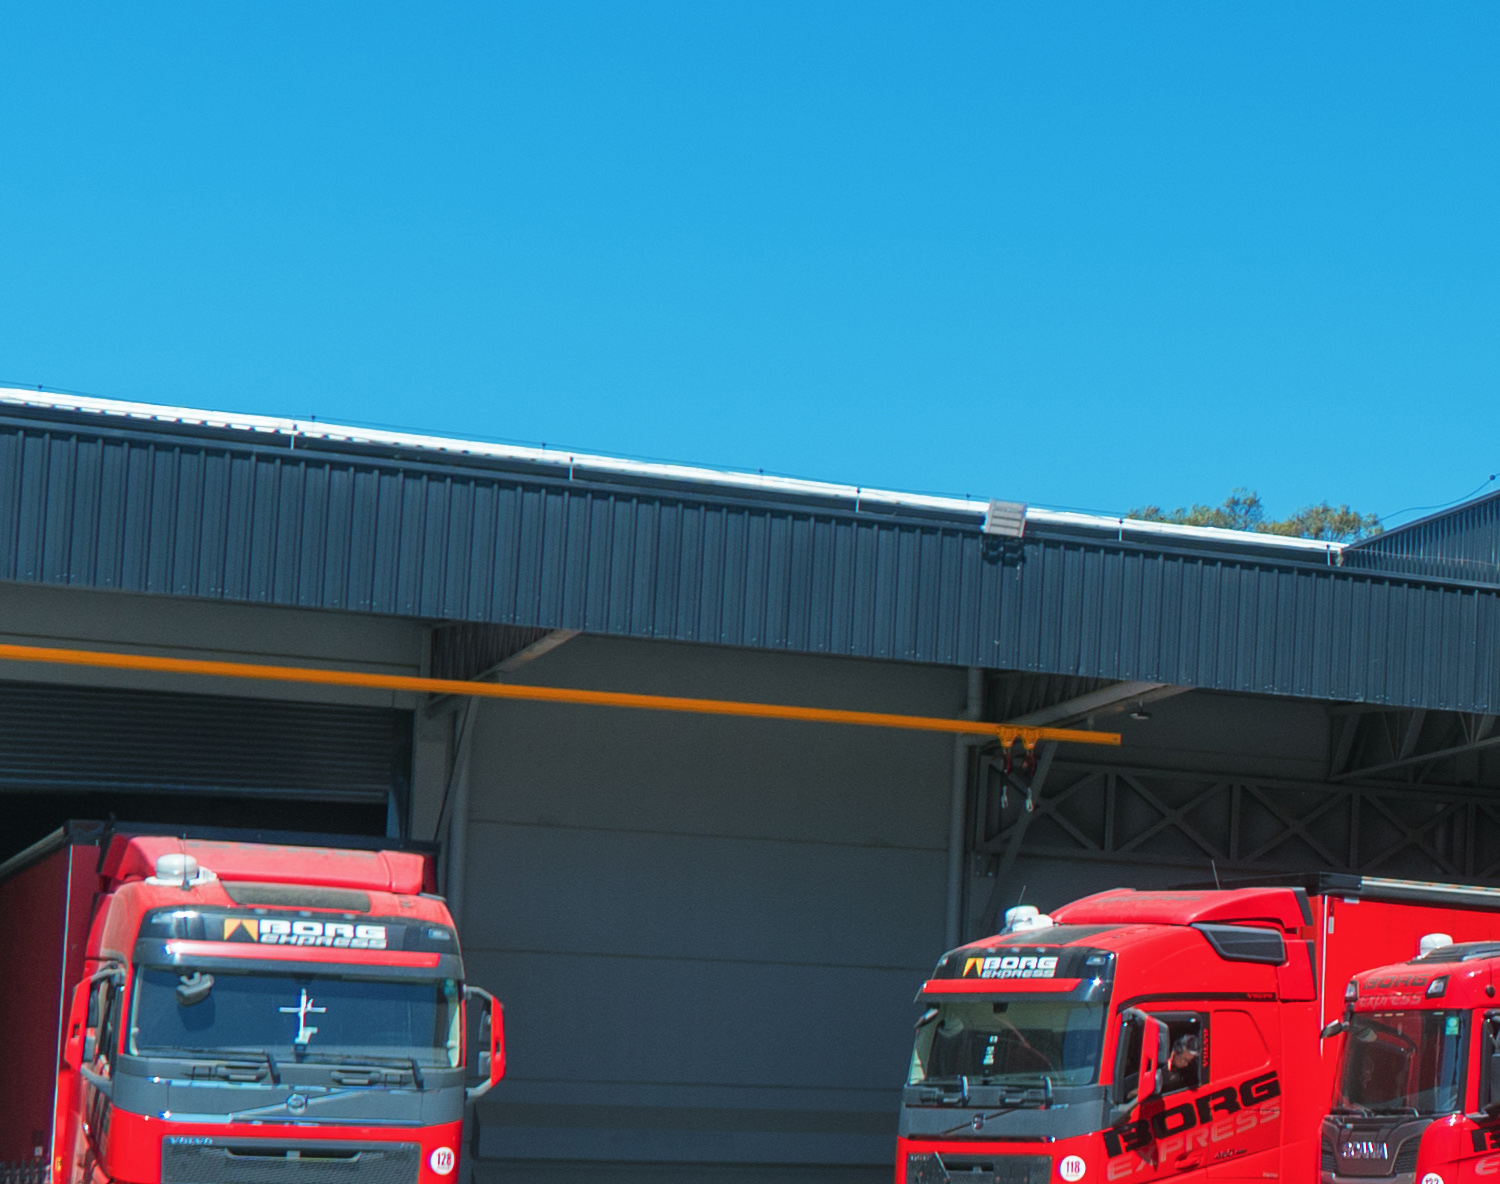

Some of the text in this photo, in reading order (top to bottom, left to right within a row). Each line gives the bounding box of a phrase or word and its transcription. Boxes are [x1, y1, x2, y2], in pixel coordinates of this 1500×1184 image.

[260, 919, 387, 940] BORG
[259, 932, 388, 949] EXPRESS
[984, 956, 1059, 970] BORG
[982, 967, 1056, 978] EXPRESS
[1362, 974, 1430, 990] BORG
[1103, 1070, 1281, 1158] BORG
[1107, 1097, 1280, 1181] EXPRESS
[436, 1151, 452, 1165] 128
[1342, 1141, 1388, 1160] SCANIA
[1066, 1161, 1080, 1174] 118
